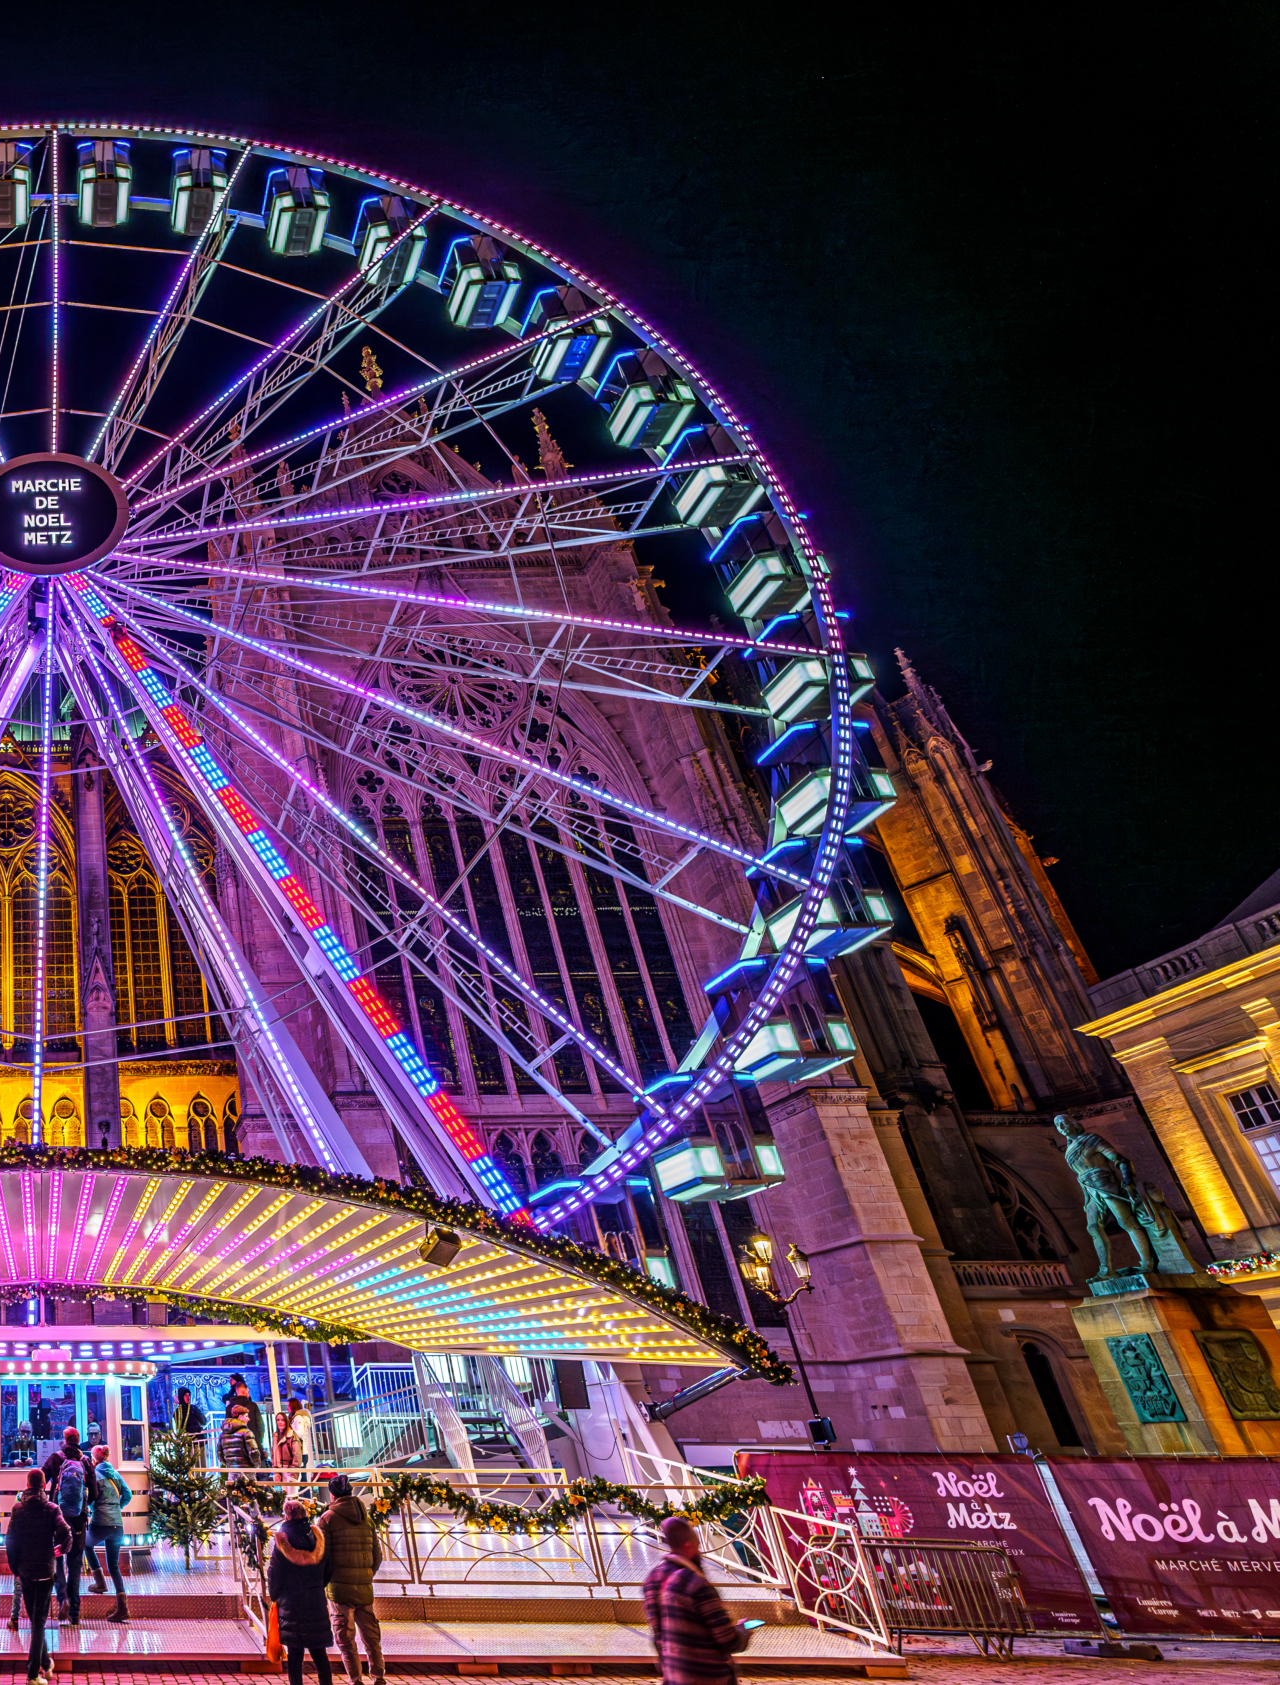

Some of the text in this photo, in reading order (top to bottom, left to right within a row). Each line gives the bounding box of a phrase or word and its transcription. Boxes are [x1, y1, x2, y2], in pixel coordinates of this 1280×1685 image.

[11, 478, 81, 492] MARCHE
[35, 496, 59, 509] DE
[24, 514, 71, 527] NOEL
[24, 531, 72, 545] METZ
[931, 1471, 1005, 1498] Noël
[970, 1499, 981, 1510] à
[946, 1502, 1018, 1530] Metz
[1087, 1497, 1215, 1543] Noël
[1216, 1510, 1248, 1543] à
[1154, 1558, 1223, 1572] MARCHÉ
